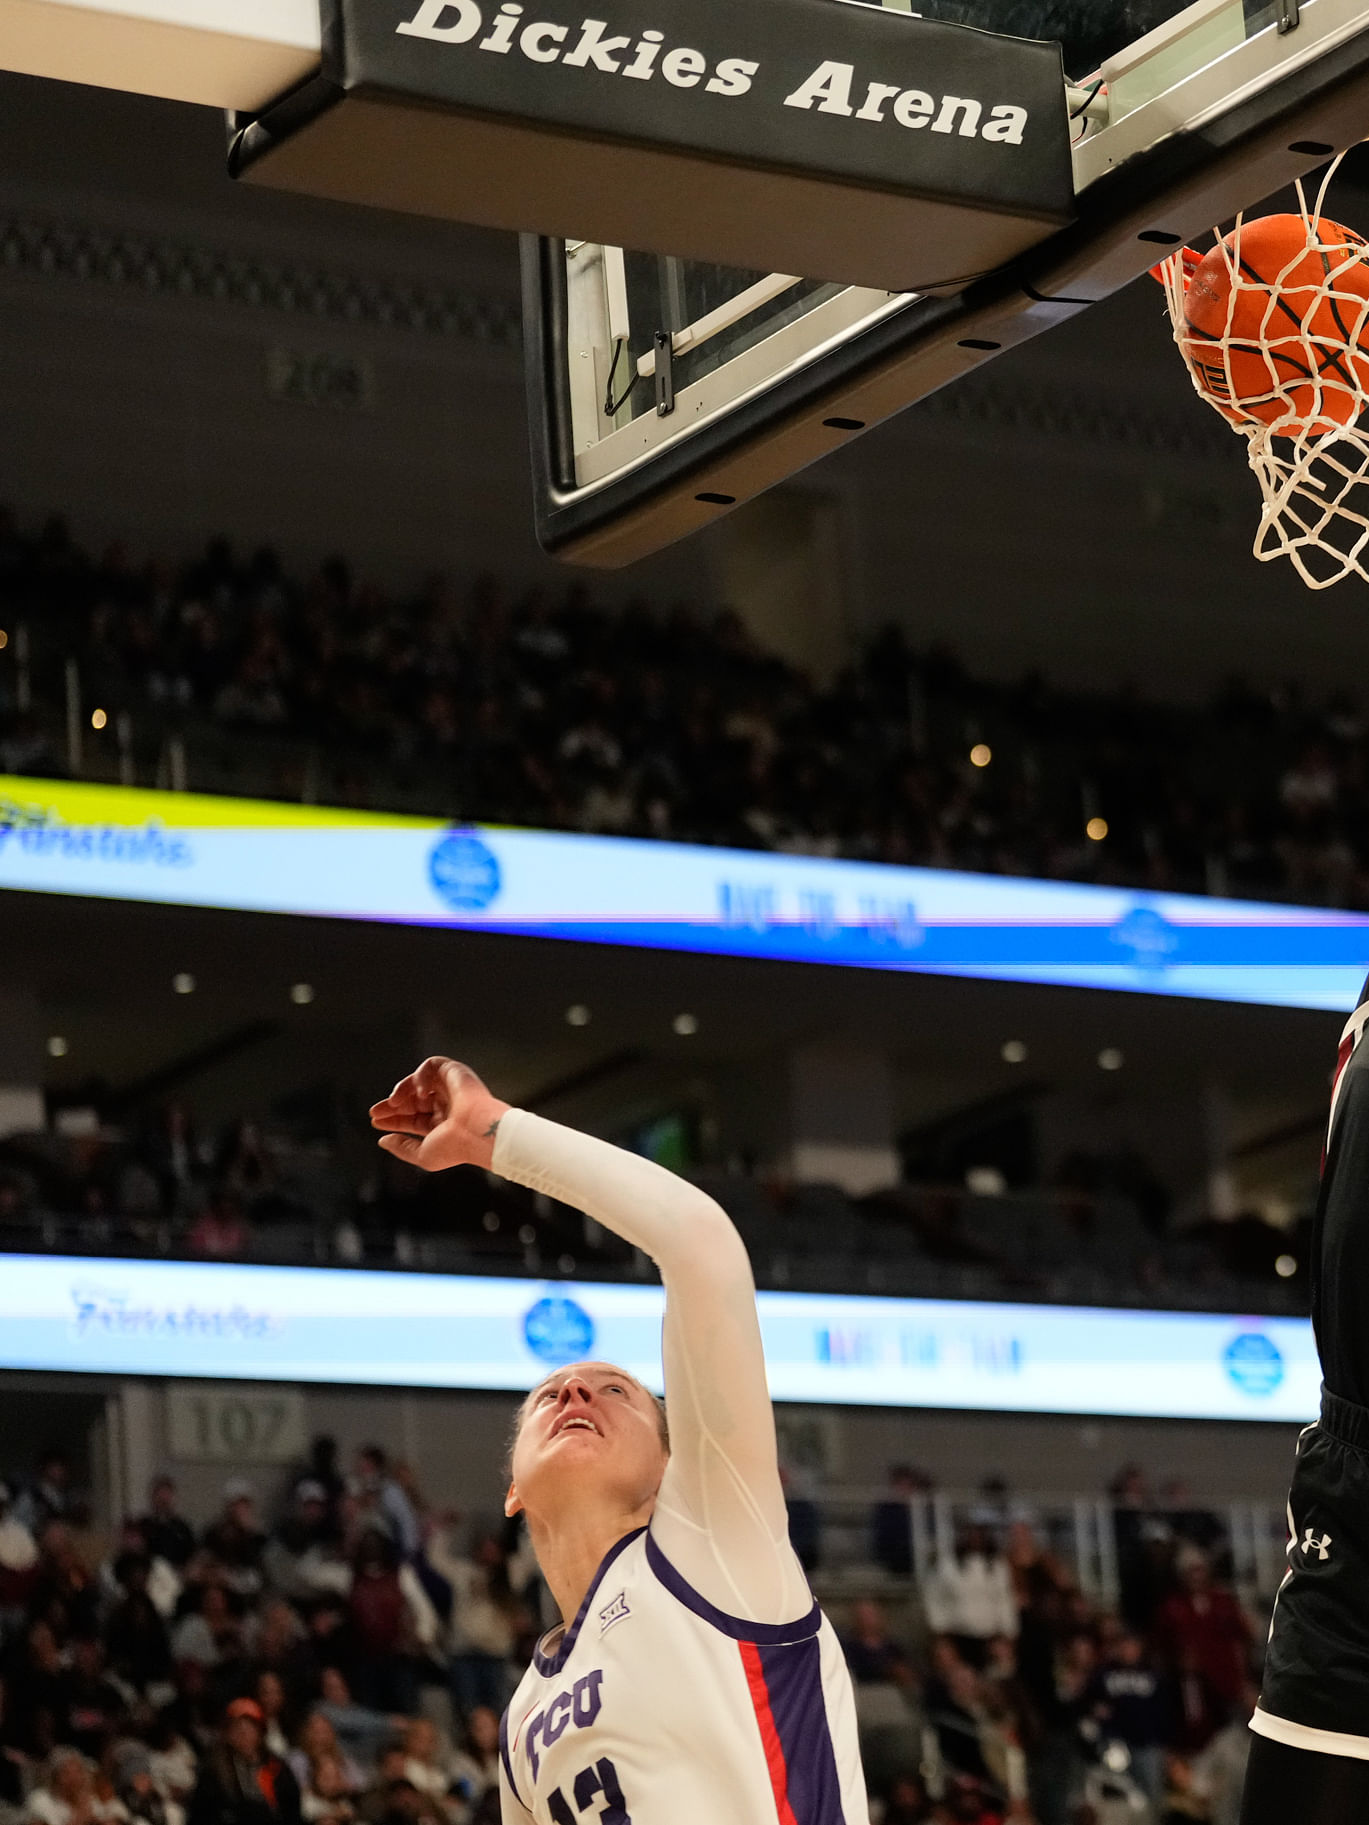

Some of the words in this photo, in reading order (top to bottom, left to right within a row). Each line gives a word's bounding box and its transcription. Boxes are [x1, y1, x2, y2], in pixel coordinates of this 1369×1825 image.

[395, 0, 760, 97] Dickies
[783, 60, 1029, 145] Arena
[193, 1397, 286, 1448] 107
[526, 1669, 603, 1785] TCU
